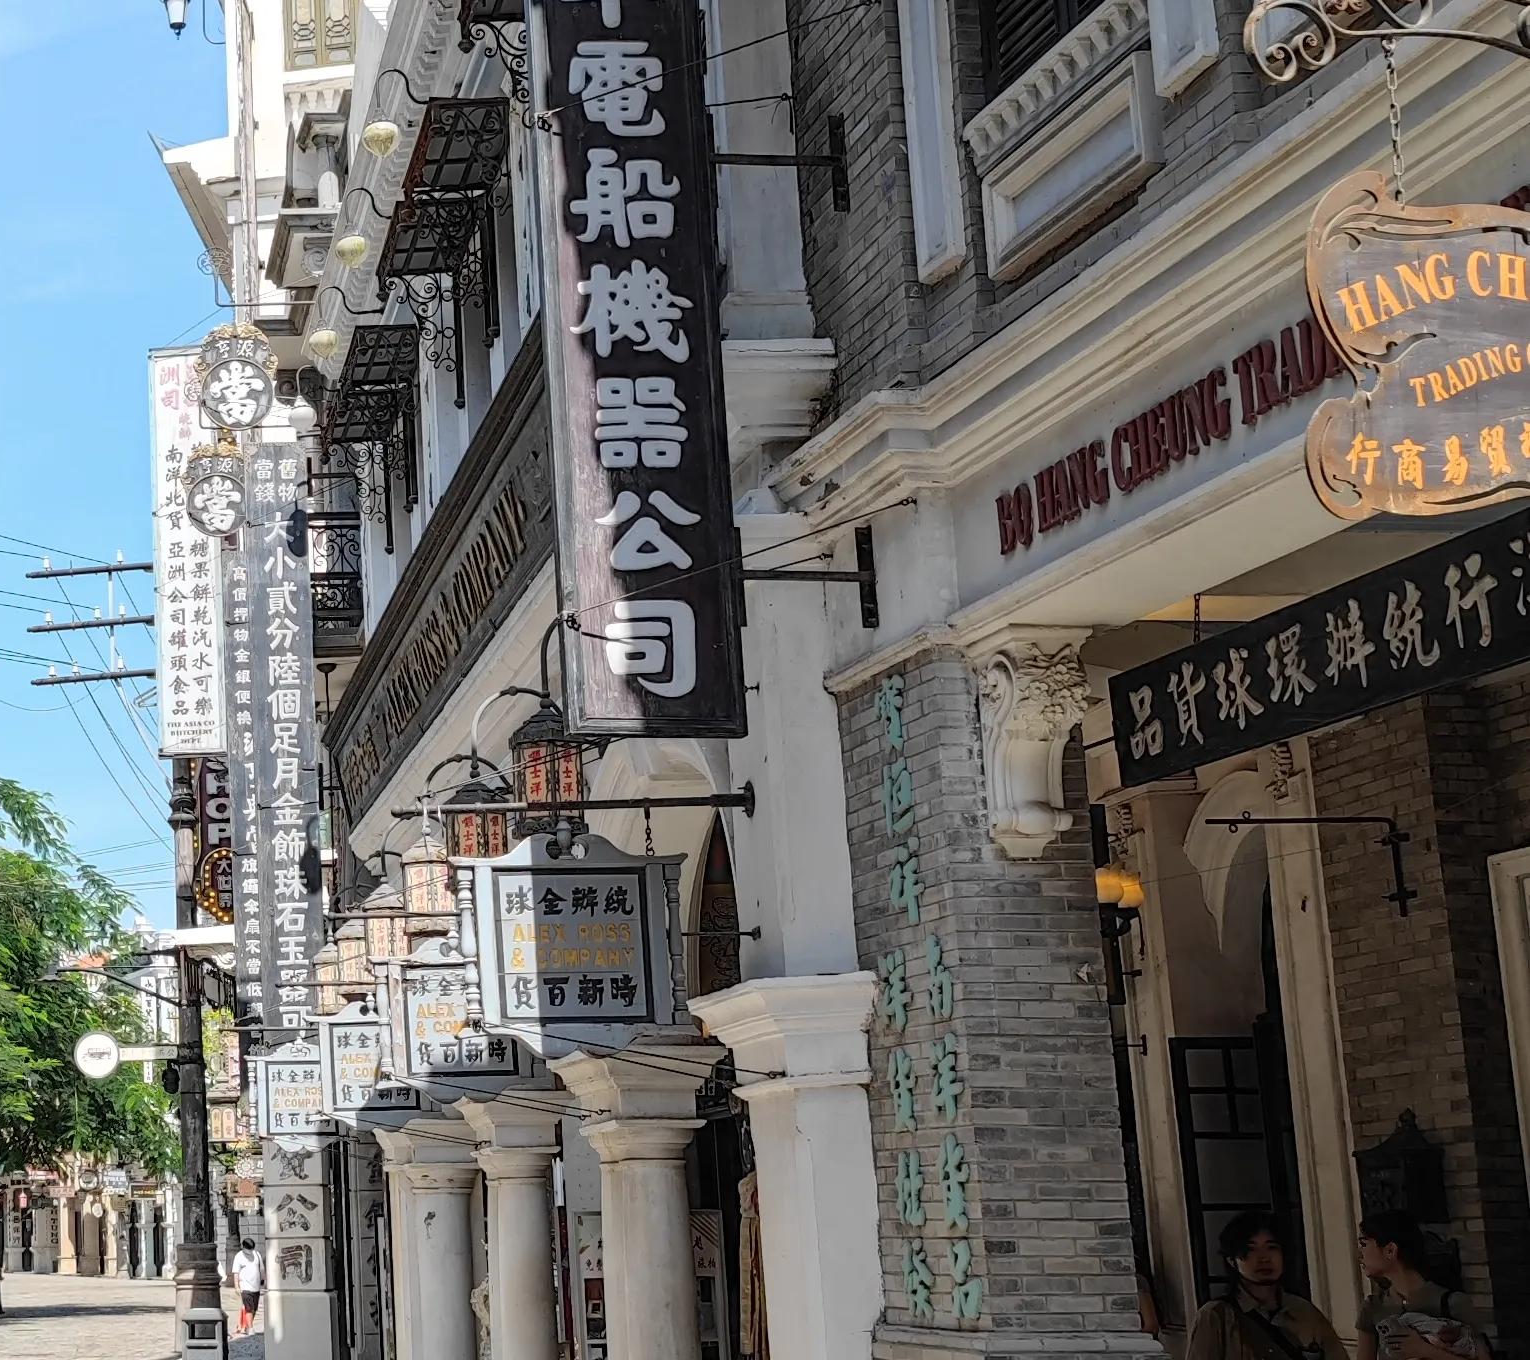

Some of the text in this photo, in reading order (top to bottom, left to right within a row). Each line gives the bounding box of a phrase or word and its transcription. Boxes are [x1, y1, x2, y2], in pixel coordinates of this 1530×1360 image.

[1336, 252, 1456, 334] HANG
[1409, 343, 1522, 408] TRADING
[994, 482, 1035, 556] BO
[1033, 440, 1110, 534] HANG
[1110, 367, 1233, 493] CHEUNG
[512, 922, 632, 944] ALEX ROSS
[510, 946, 636, 970] & COMPANY
[416, 1002, 456, 1019] ALEX
[341, 1053, 372, 1065] ALEX
